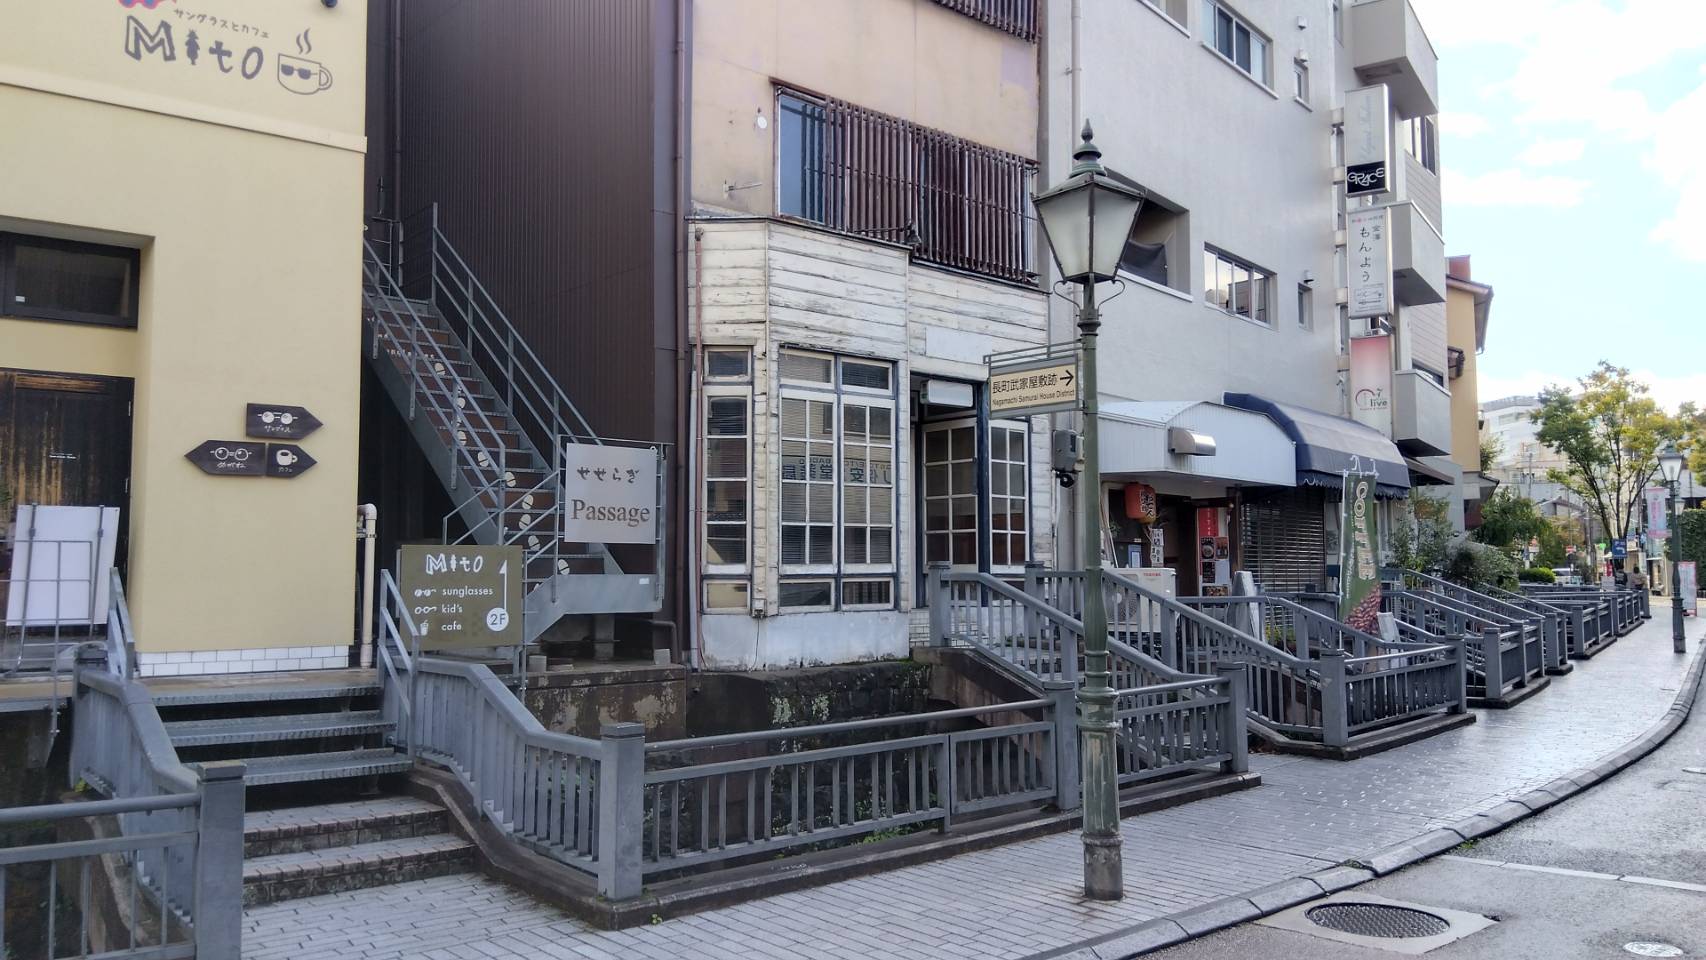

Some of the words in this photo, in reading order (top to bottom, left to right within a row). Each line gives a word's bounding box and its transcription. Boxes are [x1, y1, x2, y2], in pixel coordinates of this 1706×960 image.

[173, 8, 270, 39] サングラスとカフェ
[1347, 167, 1385, 187] GRACE
[1359, 226, 1371, 282] もんよう
[992, 373, 1057, 394] 長町武家屋敷跡
[992, 397, 1018, 406] Nagamachi
[1018, 394, 1038, 403] Samurai
[1040, 392, 1055, 400] House
[1056, 389, 1074, 398] District
[576, 466, 640, 484] せせらぎ
[571, 498, 650, 528] Passage
[1354, 481, 1376, 580] COFFEE
[442, 585, 494, 599] sunglasses
[441, 603, 463, 615] kid's
[441, 620, 462, 631] cafe
[490, 613, 507, 626] 2F
